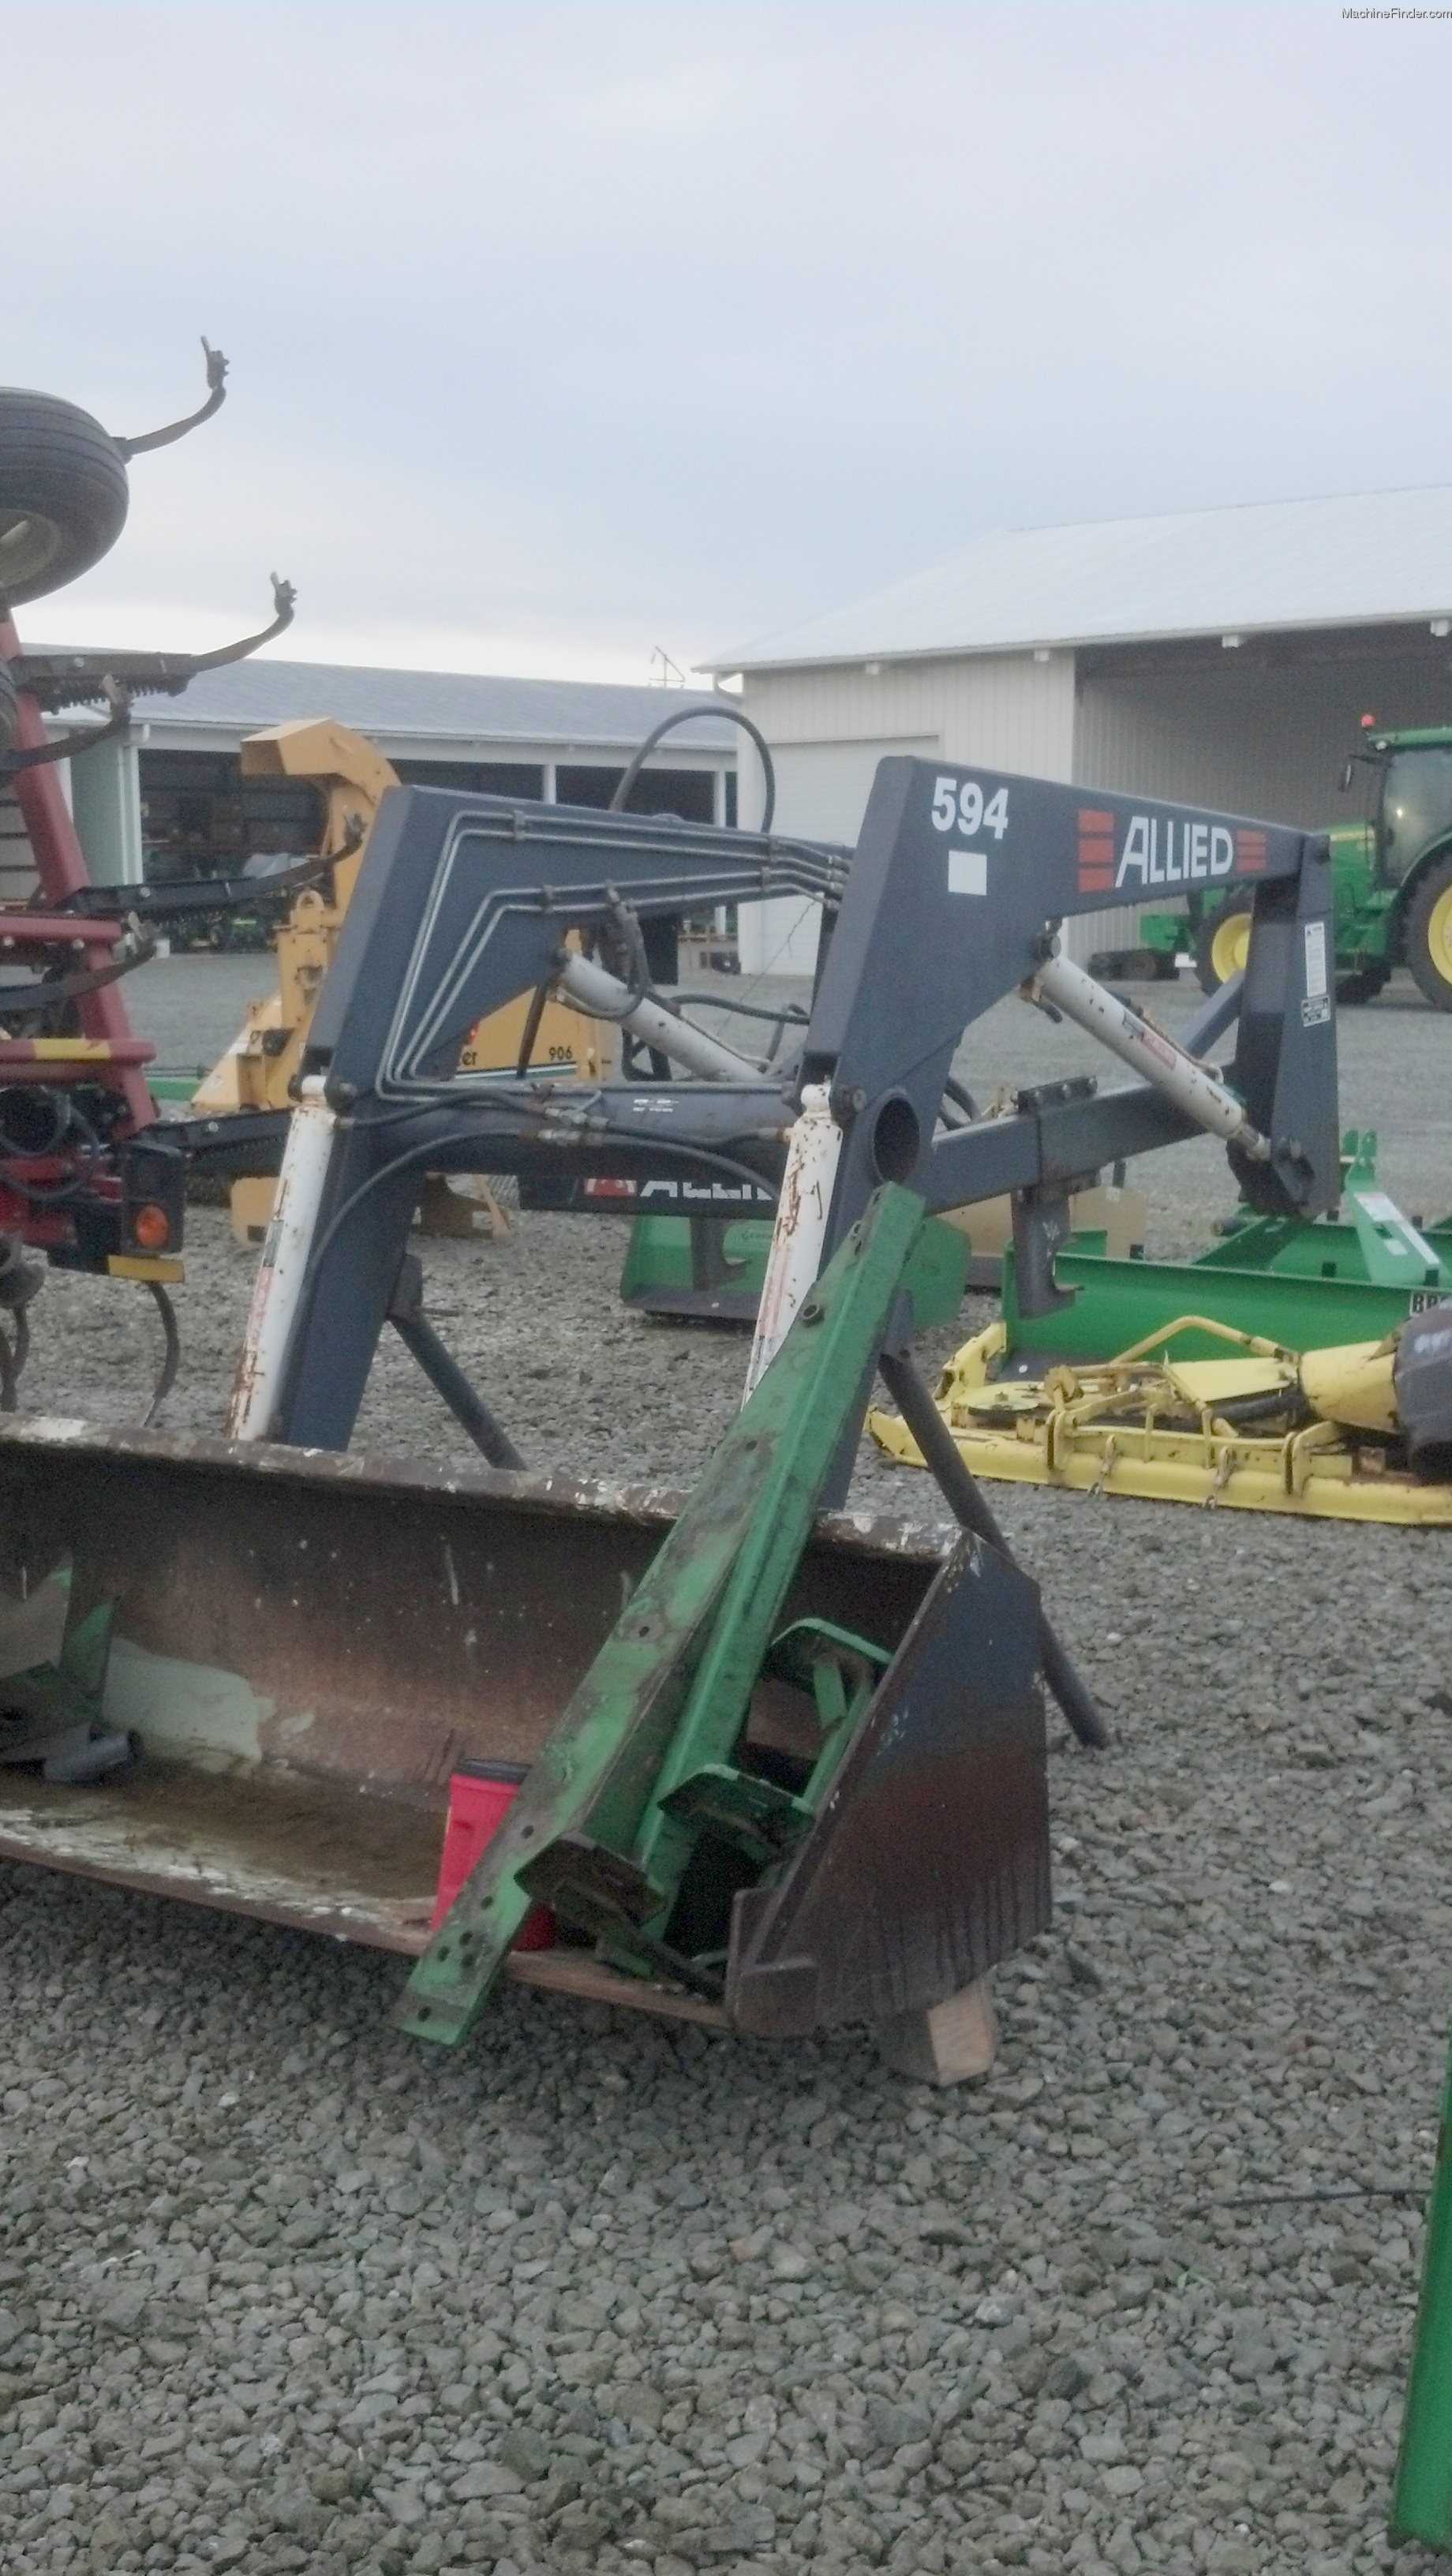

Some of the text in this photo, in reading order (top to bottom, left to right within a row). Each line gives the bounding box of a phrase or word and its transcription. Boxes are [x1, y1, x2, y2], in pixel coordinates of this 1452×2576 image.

[932, 777, 1009, 839] 594
[1114, 815, 1233, 888] ALLIED
[548, 1046, 573, 1061] 906
